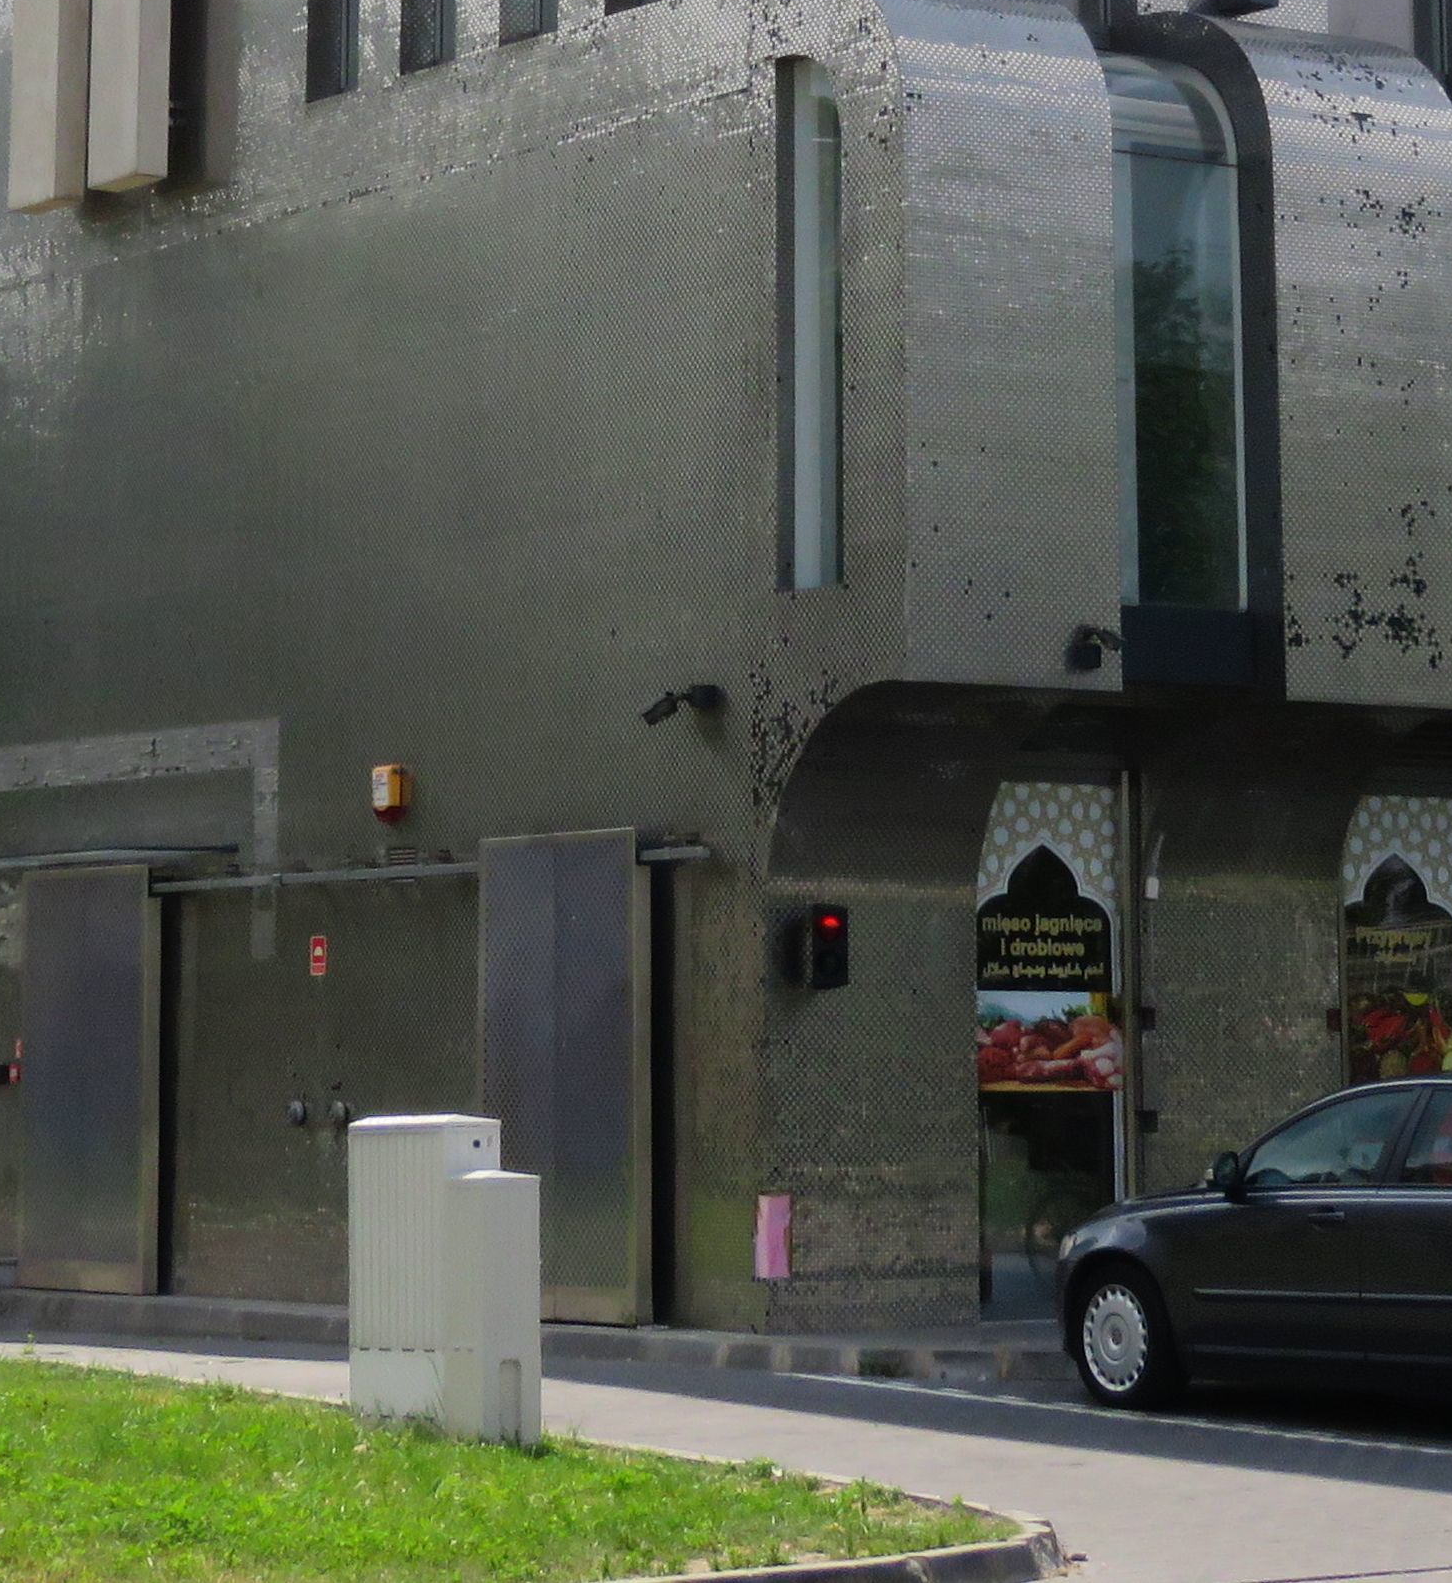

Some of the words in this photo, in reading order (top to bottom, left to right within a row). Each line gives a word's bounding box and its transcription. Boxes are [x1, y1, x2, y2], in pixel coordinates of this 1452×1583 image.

[982, 913, 1031, 936] mięso
[1034, 913, 1103, 937] jagnięce
[1010, 937, 1085, 957] drobiowe
